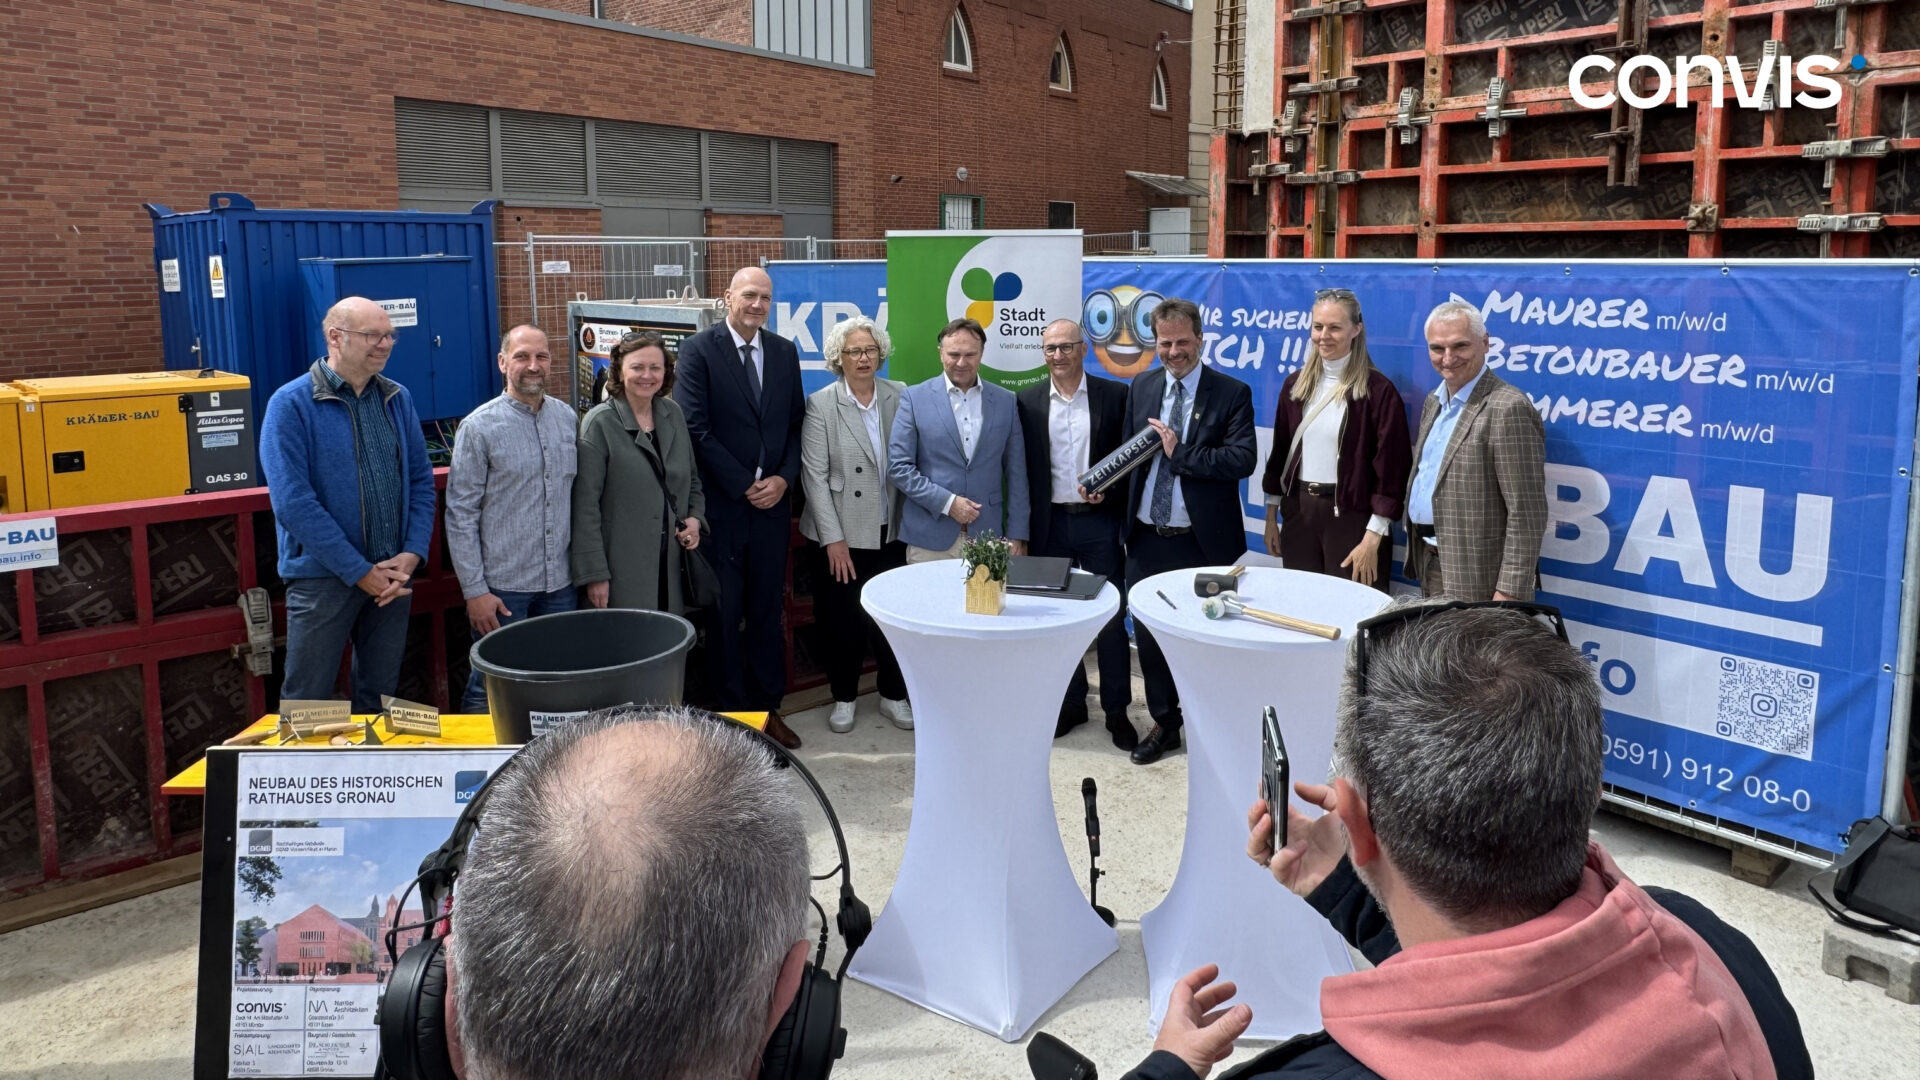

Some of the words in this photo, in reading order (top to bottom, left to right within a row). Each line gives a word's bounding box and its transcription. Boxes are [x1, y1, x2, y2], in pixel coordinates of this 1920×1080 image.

[1525, 2, 1563, 35] PERI
[1000, 307, 1046, 321] Stadt
[1231, 308, 1313, 331] SUCHEN
[1481, 289, 1650, 331] MAURER
[1656, 311, 1727, 333] m/w/d
[1484, 336, 1747, 388] BETONBAUER
[1755, 371, 1835, 394] m/w/d
[197, 417, 221, 426] Atlas
[221, 416, 245, 425] Copco
[1700, 419, 1774, 444] m/w/d
[1087, 435, 1153, 486] ZEITKAPSEL
[206, 473, 231, 484] QAS
[234, 472, 248, 481] 30
[1540, 462, 1834, 603] BAU
[249, 776, 307, 790] NEUBAU
[310, 776, 338, 789] DES
[341, 775, 444, 789] HISTORISCHEN
[1681, 757, 1734, 792] 912
[1743, 775, 1812, 813] 08-0
[248, 792, 333, 805] RATHAUSES
[336, 791, 397, 804] GRONAU
